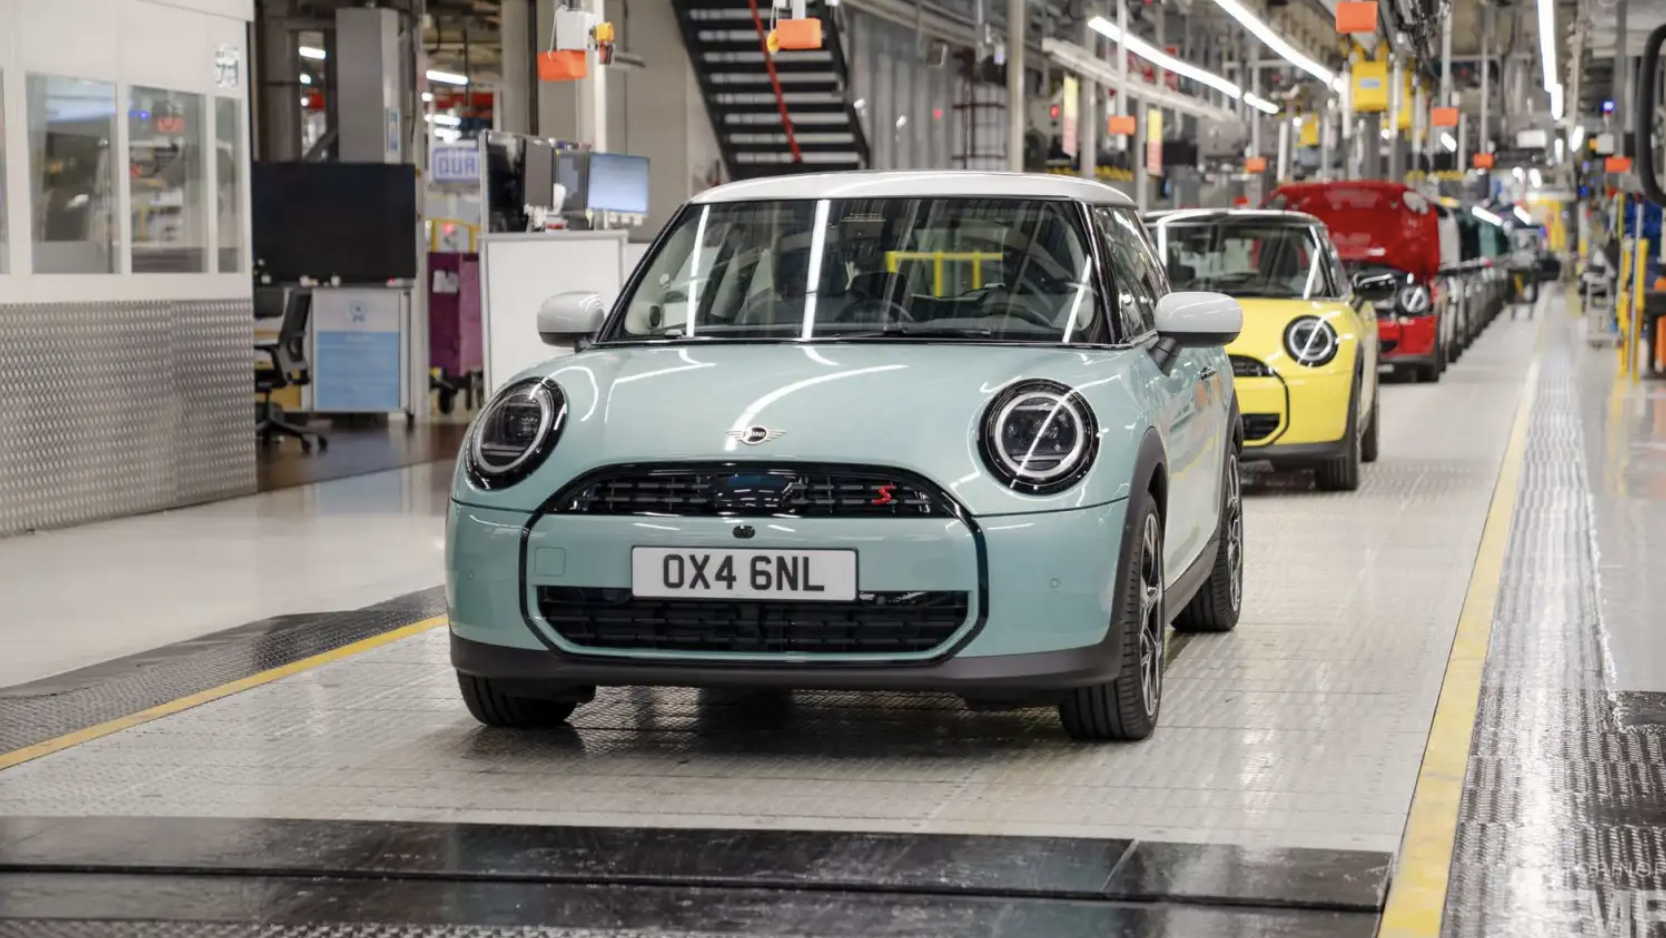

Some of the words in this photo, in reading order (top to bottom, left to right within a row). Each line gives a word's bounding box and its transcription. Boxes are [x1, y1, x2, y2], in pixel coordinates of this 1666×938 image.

[871, 484, 894, 504] S
[663, 554, 736, 590] OX4
[750, 555, 825, 592] 6NL
